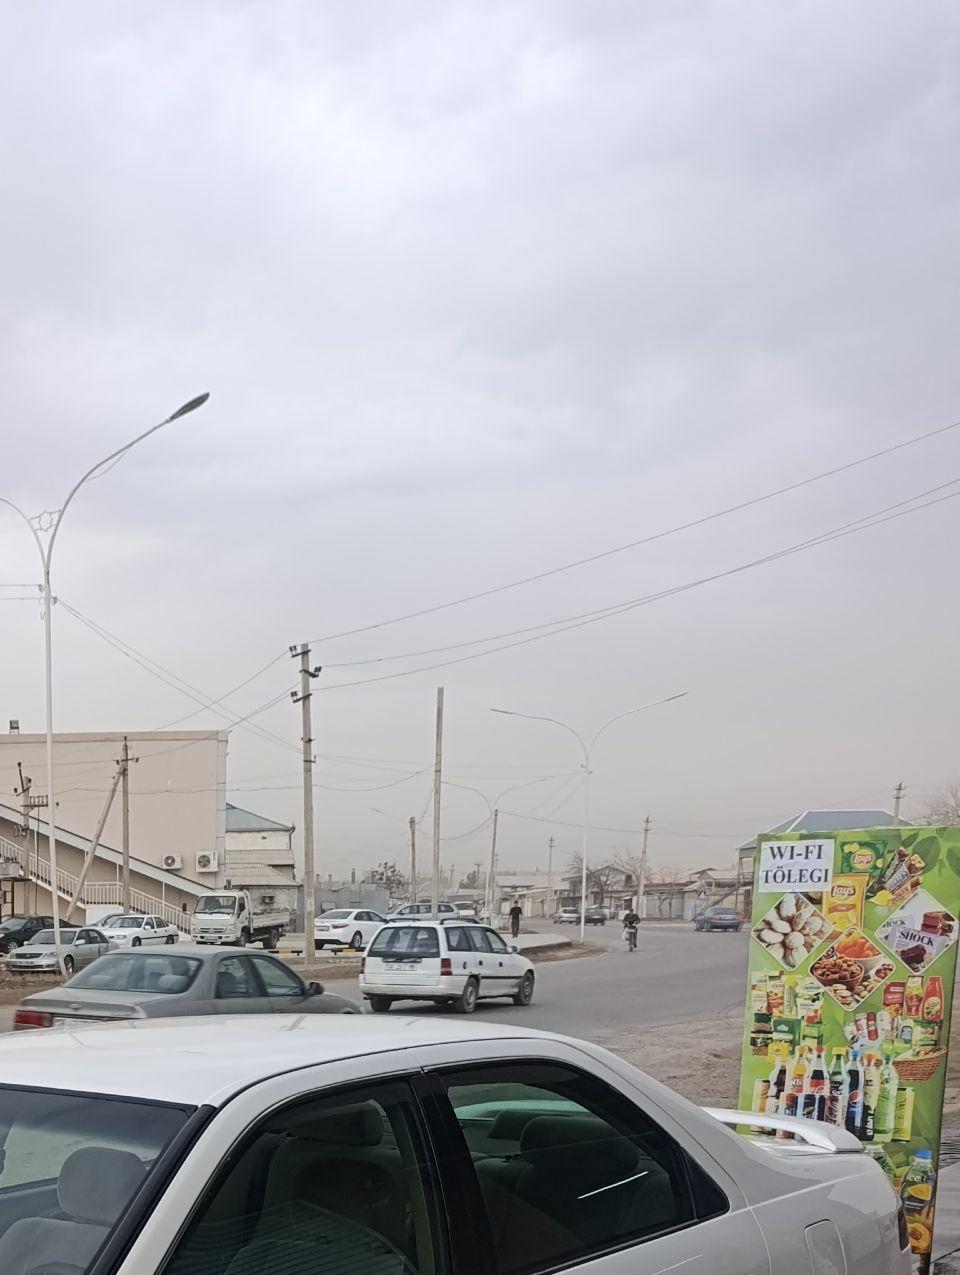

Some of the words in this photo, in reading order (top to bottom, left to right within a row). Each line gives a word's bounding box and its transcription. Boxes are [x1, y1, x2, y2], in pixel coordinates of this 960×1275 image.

[770, 845, 824, 861] WI-FI
[762, 866, 830, 884] TÖLEGI
[899, 930, 935, 947] SHOCK
